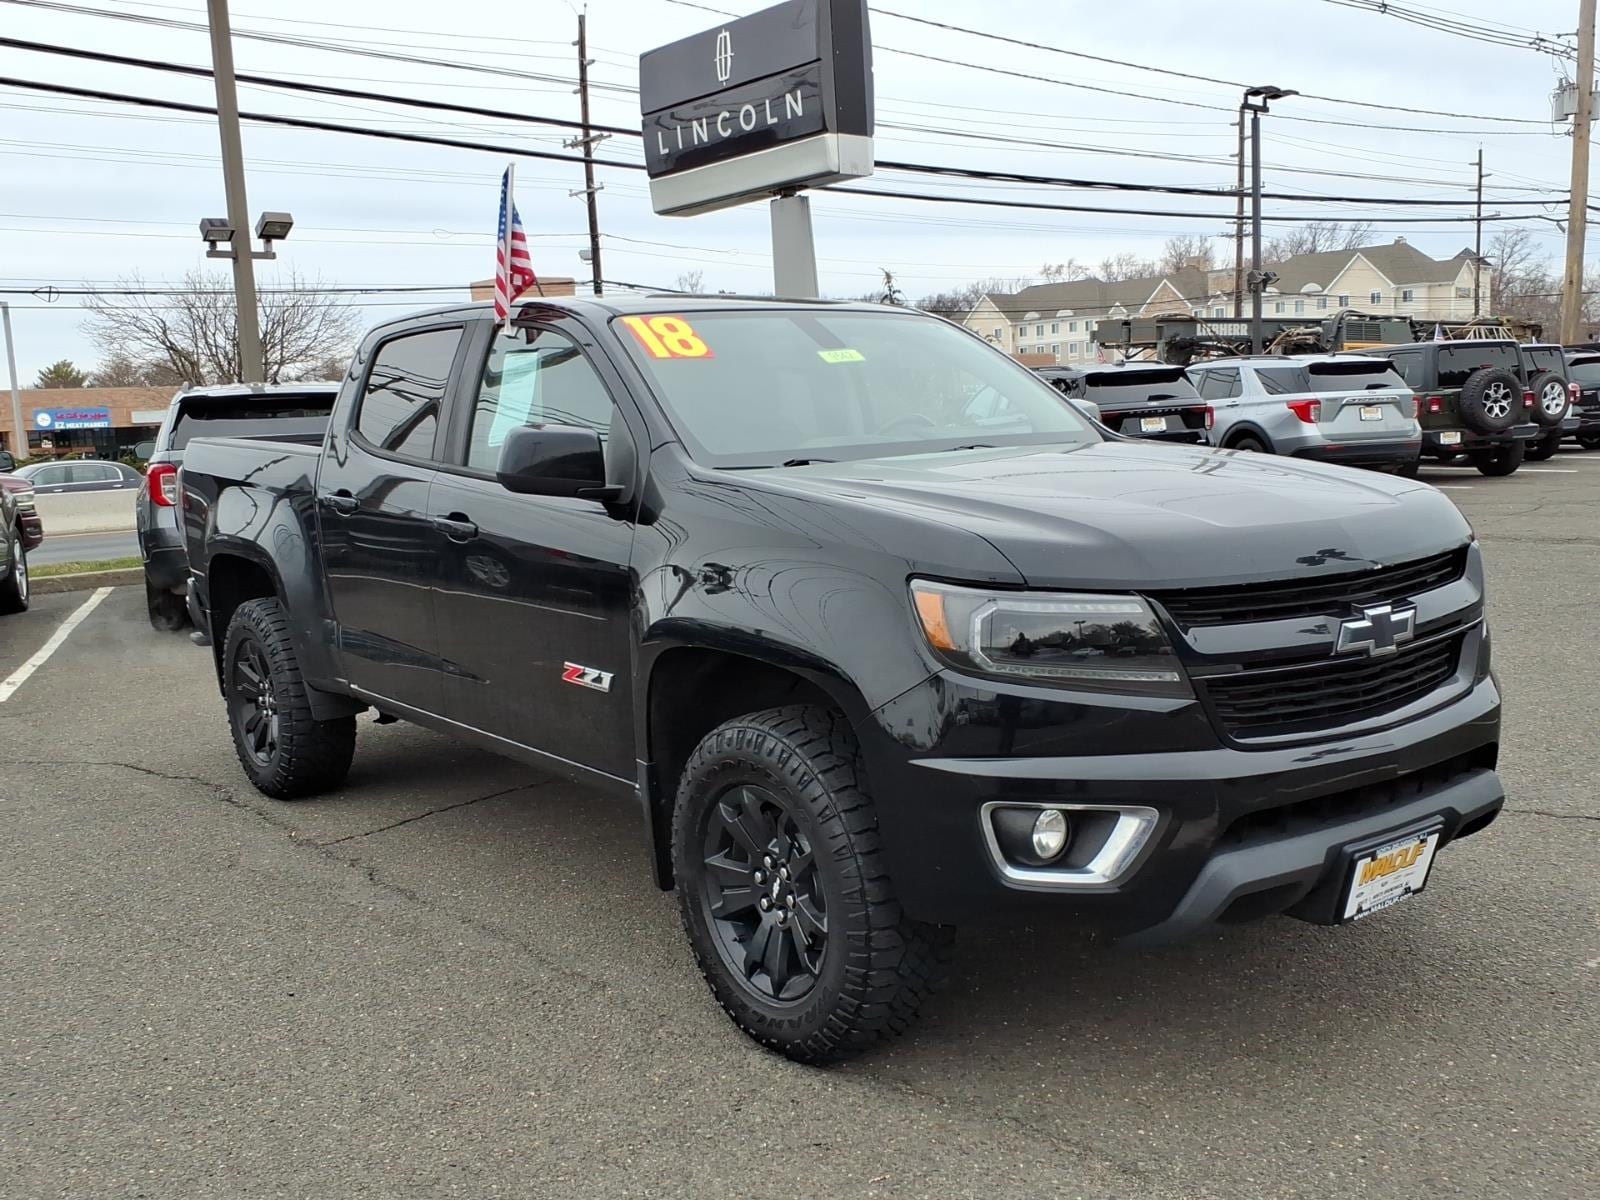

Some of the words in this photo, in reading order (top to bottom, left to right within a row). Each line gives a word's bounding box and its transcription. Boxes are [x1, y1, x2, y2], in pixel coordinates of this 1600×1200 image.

[658, 89, 804, 155] LINCOLN
[622, 316, 709, 358] 18
[562, 660, 615, 693] Z71
[1358, 842, 1427, 887] MALOUF
